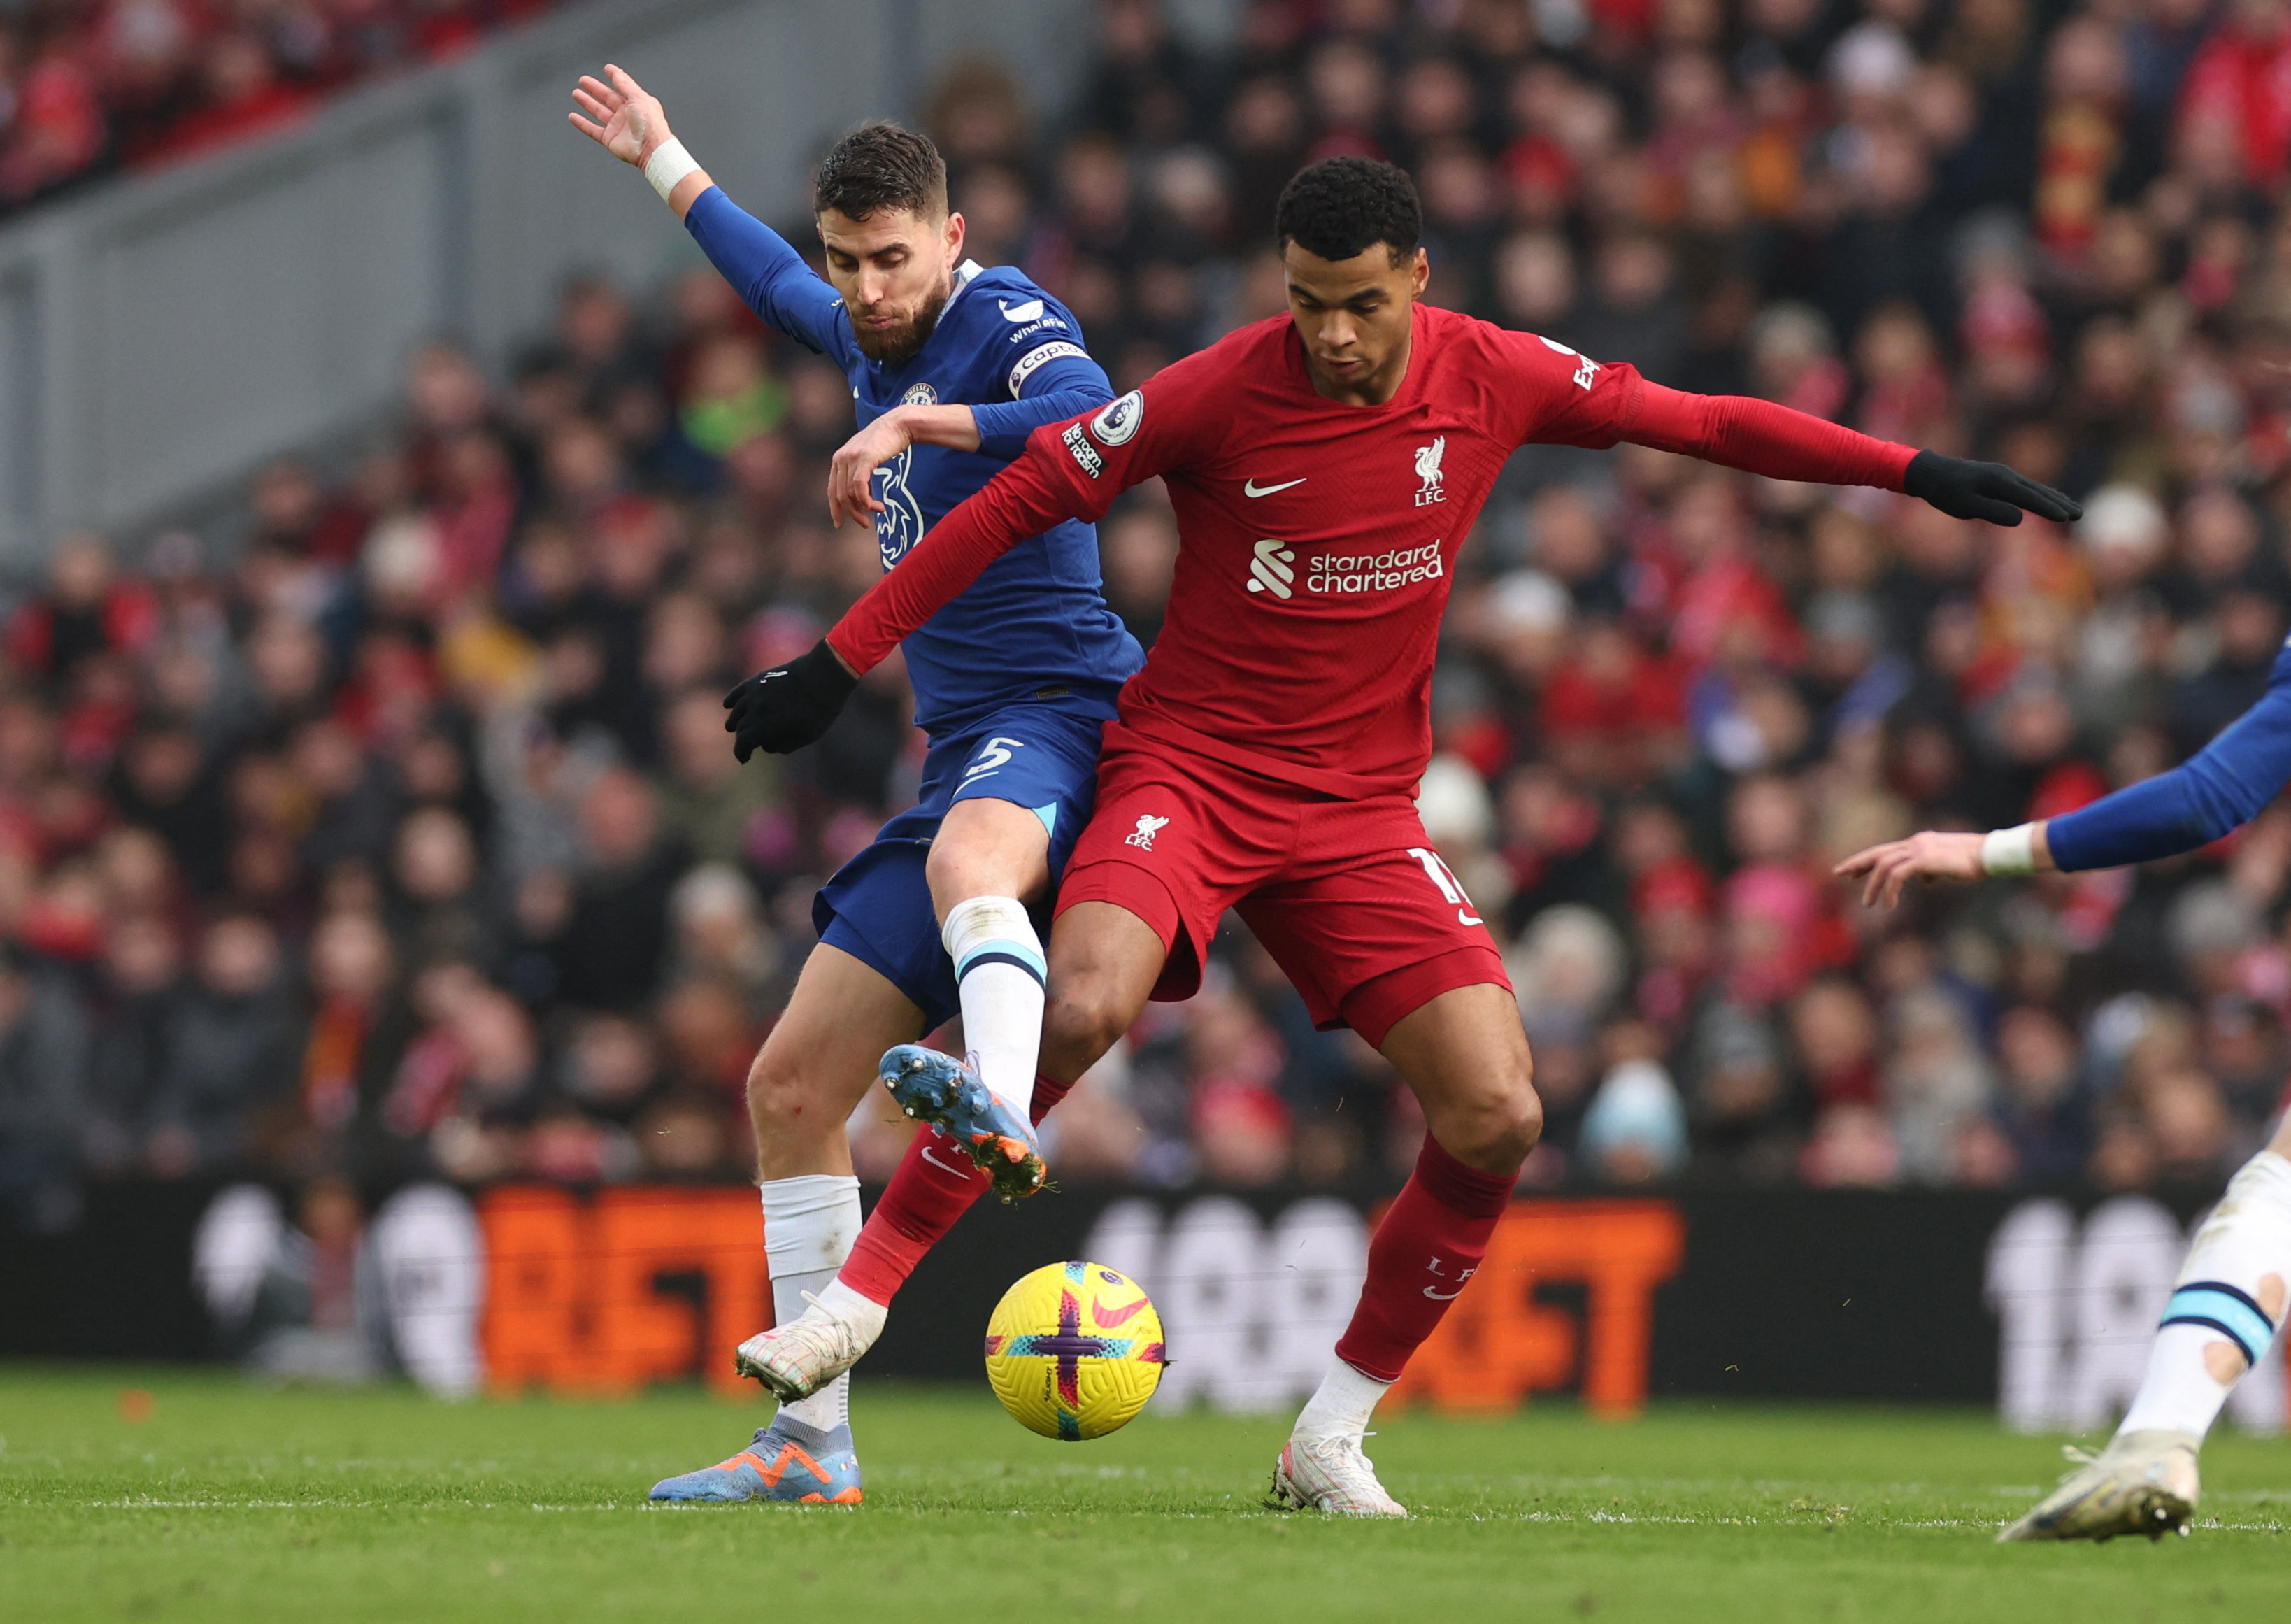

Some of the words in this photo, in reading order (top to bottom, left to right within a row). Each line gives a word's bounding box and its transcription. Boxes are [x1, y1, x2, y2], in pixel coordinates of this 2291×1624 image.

[1009, 318, 1067, 343] WhaleFin
[905, 385, 930, 400] CHELSEA
[1070, 443, 1100, 479] racism
[1071, 422, 1083, 440] No
[1078, 437, 1102, 468] room
[1309, 538, 1441, 572] standard
[1307, 554, 1444, 593] chartered
[965, 736, 1025, 778] 5
